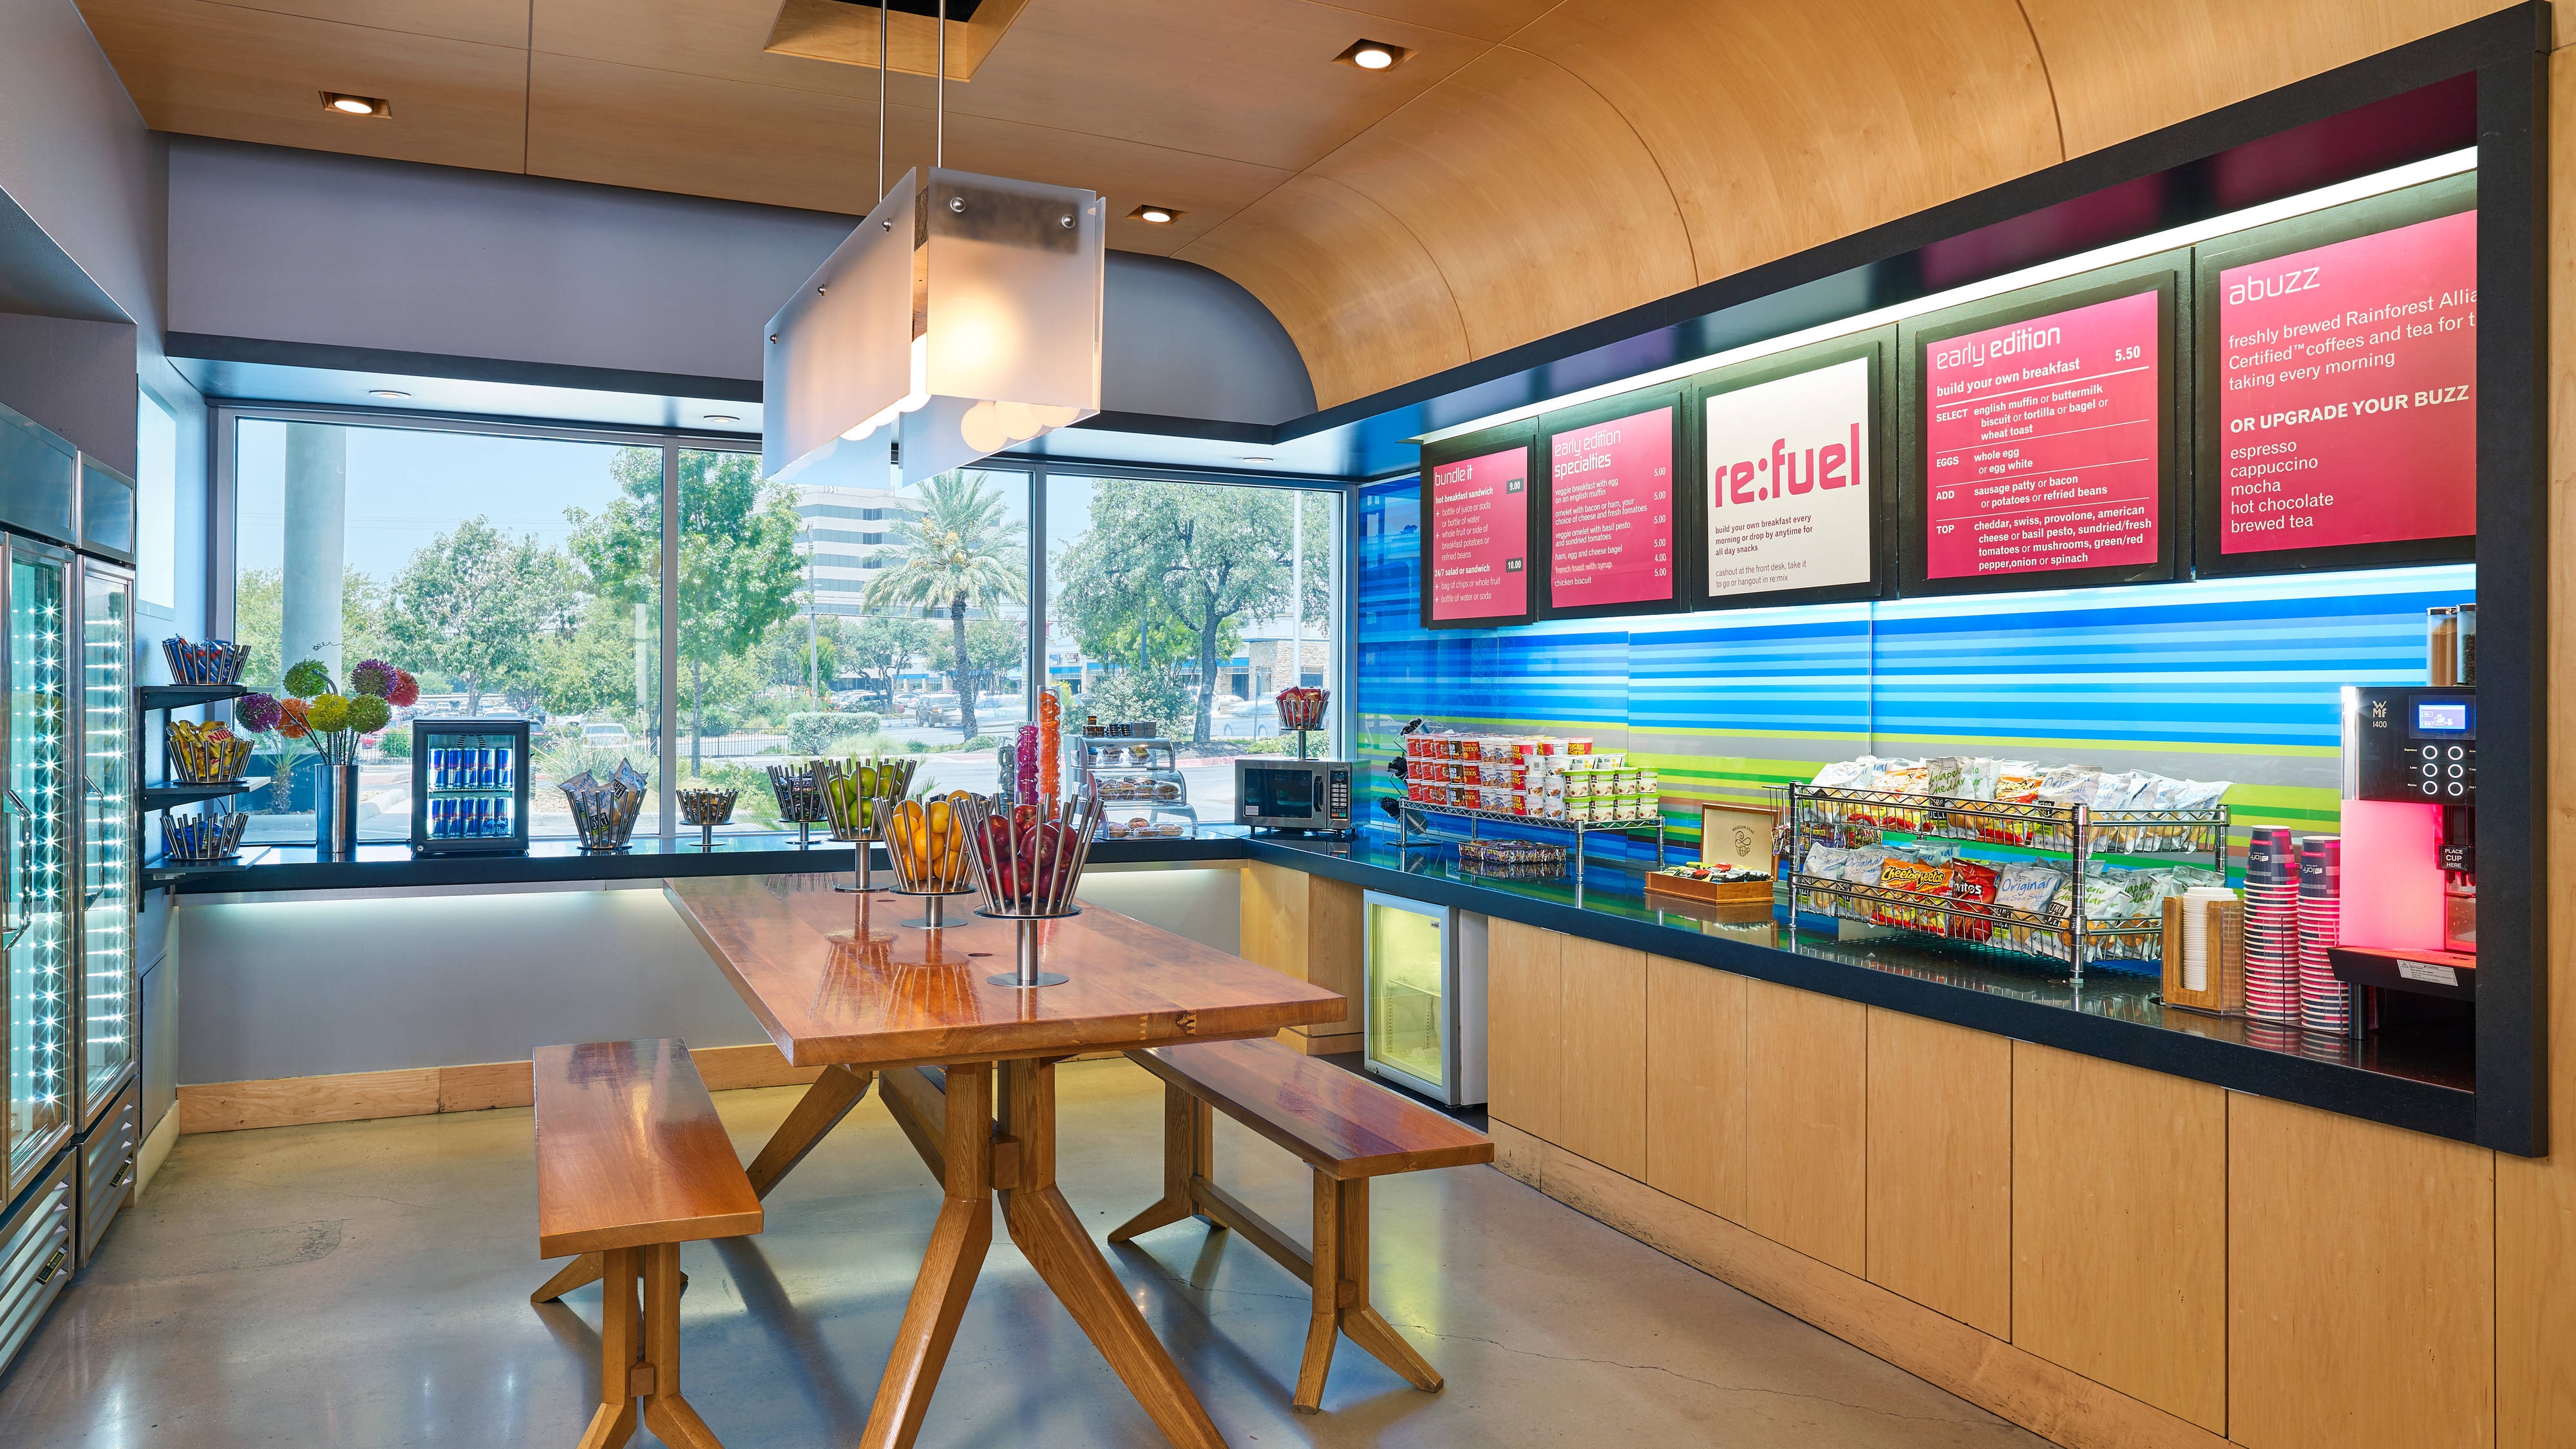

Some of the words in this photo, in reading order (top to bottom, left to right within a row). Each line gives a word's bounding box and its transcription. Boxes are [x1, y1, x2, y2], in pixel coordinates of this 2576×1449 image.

[2230, 265, 2320, 305] abuzz
[2228, 328, 2278, 348] freshly
[2284, 314, 2340, 338] brewed
[2347, 296, 2434, 326] Rainforest
[2306, 336, 2363, 355] coffees
[2369, 325, 2400, 345] and
[2407, 323, 2432, 337] tea
[2438, 316, 2463, 332] for
[1937, 341, 1984, 370] early
[1990, 327, 2060, 358] edition
[2115, 345, 2140, 362] 5.50
[1937, 381, 1964, 397] build
[1967, 377, 1993, 393] your
[1995, 372, 2019, 385] own
[2023, 357, 2079, 380] breakfast
[2228, 373, 2274, 390] taking
[2279, 365, 2320, 382] every
[2325, 352, 2394, 374] morning
[1973, 401, 2006, 415] english
[2008, 396, 2038, 409] muffin
[2040, 395, 2050, 403] or
[2052, 384, 2103, 401] buttermilk
[2230, 417, 2255, 433] OR
[2260, 402, 2348, 429] UPGRADE
[2352, 394, 2408, 415] YOUR
[2414, 384, 2468, 407] BUZZ
[1936, 408, 1968, 422] SELECT
[1981, 413, 2011, 427] biscuit
[2012, 414, 2022, 422] or
[2023, 406, 2055, 420] tortilla
[2057, 406, 2067, 414] or
[2069, 399, 2096, 412] bagel
[2098, 399, 2108, 407] or
[1980, 428, 2008, 440] wheat
[2009, 423, 2033, 436] toast
[1555, 437, 1582, 457] early
[1583, 429, 1620, 451] edition
[2230, 441, 2297, 460] espresso
[1715, 422, 1860, 507] re:fuel
[1936, 456, 1959, 467] EGGS
[1974, 450, 2000, 462] whole
[2002, 448, 2019, 459] egg
[1435, 467, 1465, 486] bundle
[1467, 464, 1473, 480] it
[1554, 453, 1611, 480] specialties
[1654, 466, 1666, 477] 5.00
[1989, 464, 2005, 474] egg
[2007, 458, 2033, 470] white
[2230, 457, 2318, 478] cappuccino
[1435, 495, 1444, 504] hot
[1444, 491, 1468, 502] breakfast
[1468, 486, 1493, 498] sandwich
[1509, 481, 1520, 491] 9.00
[1654, 490, 1666, 500] 5.00
[1936, 490, 1954, 500] ADD
[1974, 484, 2010, 496] sausage
[2012, 480, 2035, 493] patty
[2037, 480, 2047, 488] or
[2049, 476, 2078, 486] bacon
[2231, 479, 2281, 496] mocha
[1991, 495, 2030, 509] potatoes
[2043, 488, 2074, 500] refried
[2078, 486, 2107, 497] beans
[2231, 499, 2254, 514] hot
[2259, 492, 2333, 512] chocolate
[1654, 514, 1666, 524] 5.00
[1715, 525, 1730, 534] build
[1731, 524, 1745, 533] your
[1761, 516, 1791, 527] breakfast
[1793, 515, 1811, 523] every
[1974, 518, 2011, 531] cheddar,
[2014, 516, 2041, 526] swiss,
[2044, 511, 2095, 526] provolone,
[2098, 506, 2144, 518] american
[2231, 515, 2284, 533] brewed
[2289, 514, 2313, 528] tea
[1715, 535, 1740, 545] morning
[1765, 530, 1773, 539] by
[1775, 527, 1801, 538] anytime
[1803, 525, 1813, 533] for
[1936, 524, 1954, 534] TOP
[1978, 533, 2009, 543] cheese
[2022, 528, 2044, 539] basil
[2047, 526, 2075, 538] pesto,
[2078, 518, 2151, 534] sundried/fresh
[1654, 538, 1666, 547] 5.00
[1724, 547, 1735, 555] day
[1736, 544, 1758, 553] snacks
[1978, 545, 2020, 556] tomatoes
[2032, 540, 2092, 552] mushrooms,
[2094, 533, 2143, 549] green/red
[1508, 560, 1521, 569] 10.00
[1654, 553, 1666, 562] 4.00
[1978, 556, 2036, 571] pepper,onion
[2050, 552, 2088, 566] spinach
[1434, 568, 1444, 577] 24/7
[1445, 566, 1458, 576] salad
[1465, 563, 1490, 574] sandwich
[1654, 567, 1666, 577] 5.00
[1881, 866, 1918, 881] Cheetos
[2002, 877, 2052, 896] Original
[2050, 903, 2064, 913] ETRO
